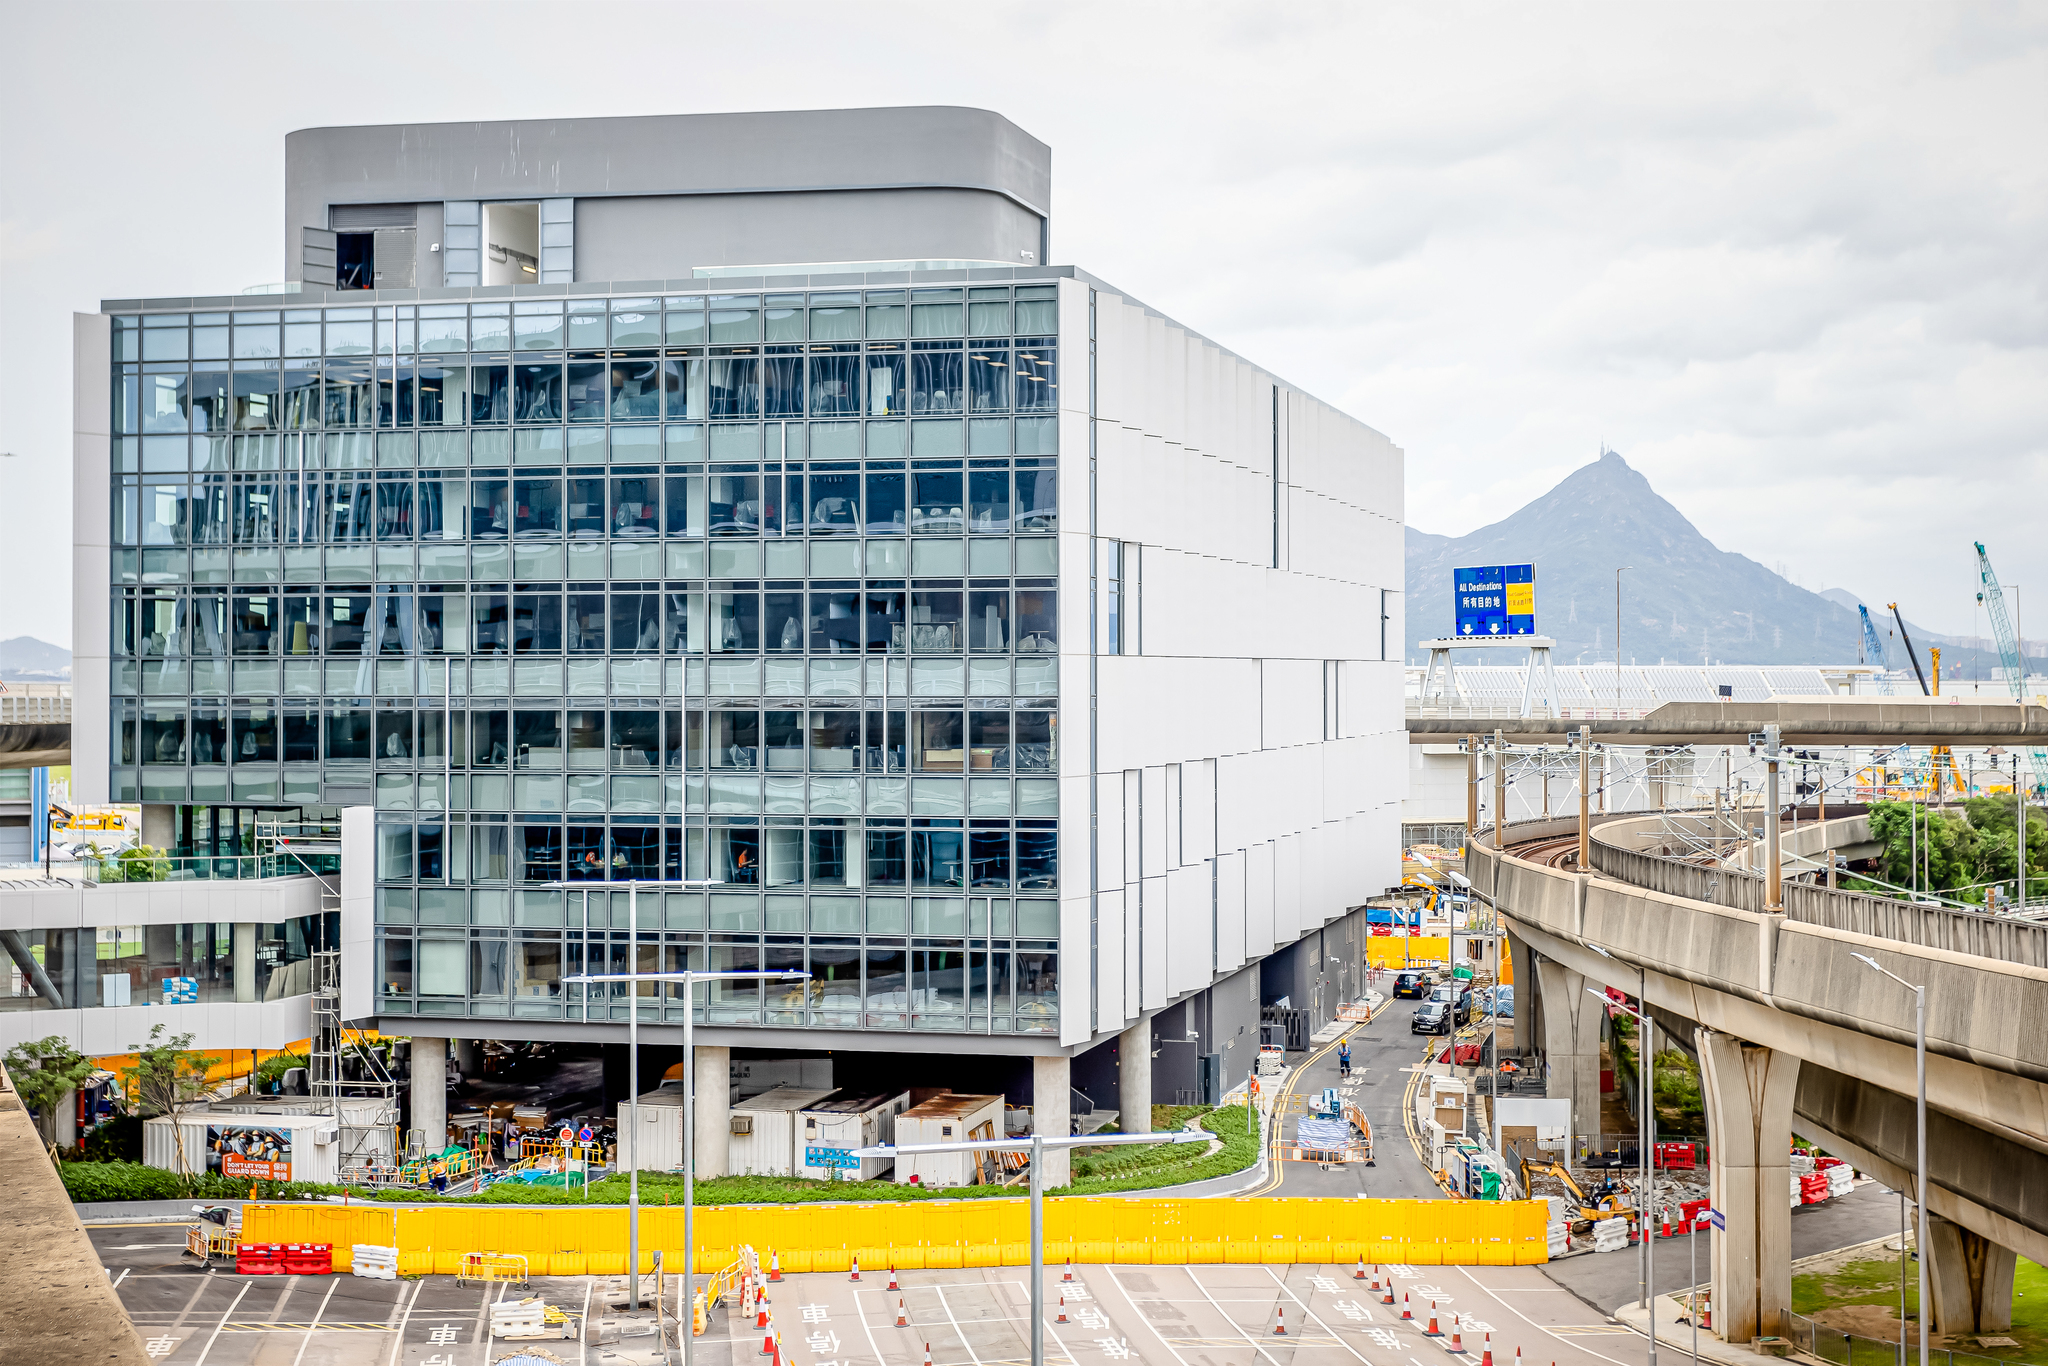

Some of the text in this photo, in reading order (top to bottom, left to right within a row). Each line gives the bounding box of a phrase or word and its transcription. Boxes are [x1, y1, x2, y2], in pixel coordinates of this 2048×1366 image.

[1468, 582, 1503, 592] Destinations
[1462, 595, 1501, 609] 所有目的地
[145, 1333, 182, 1358] 車
